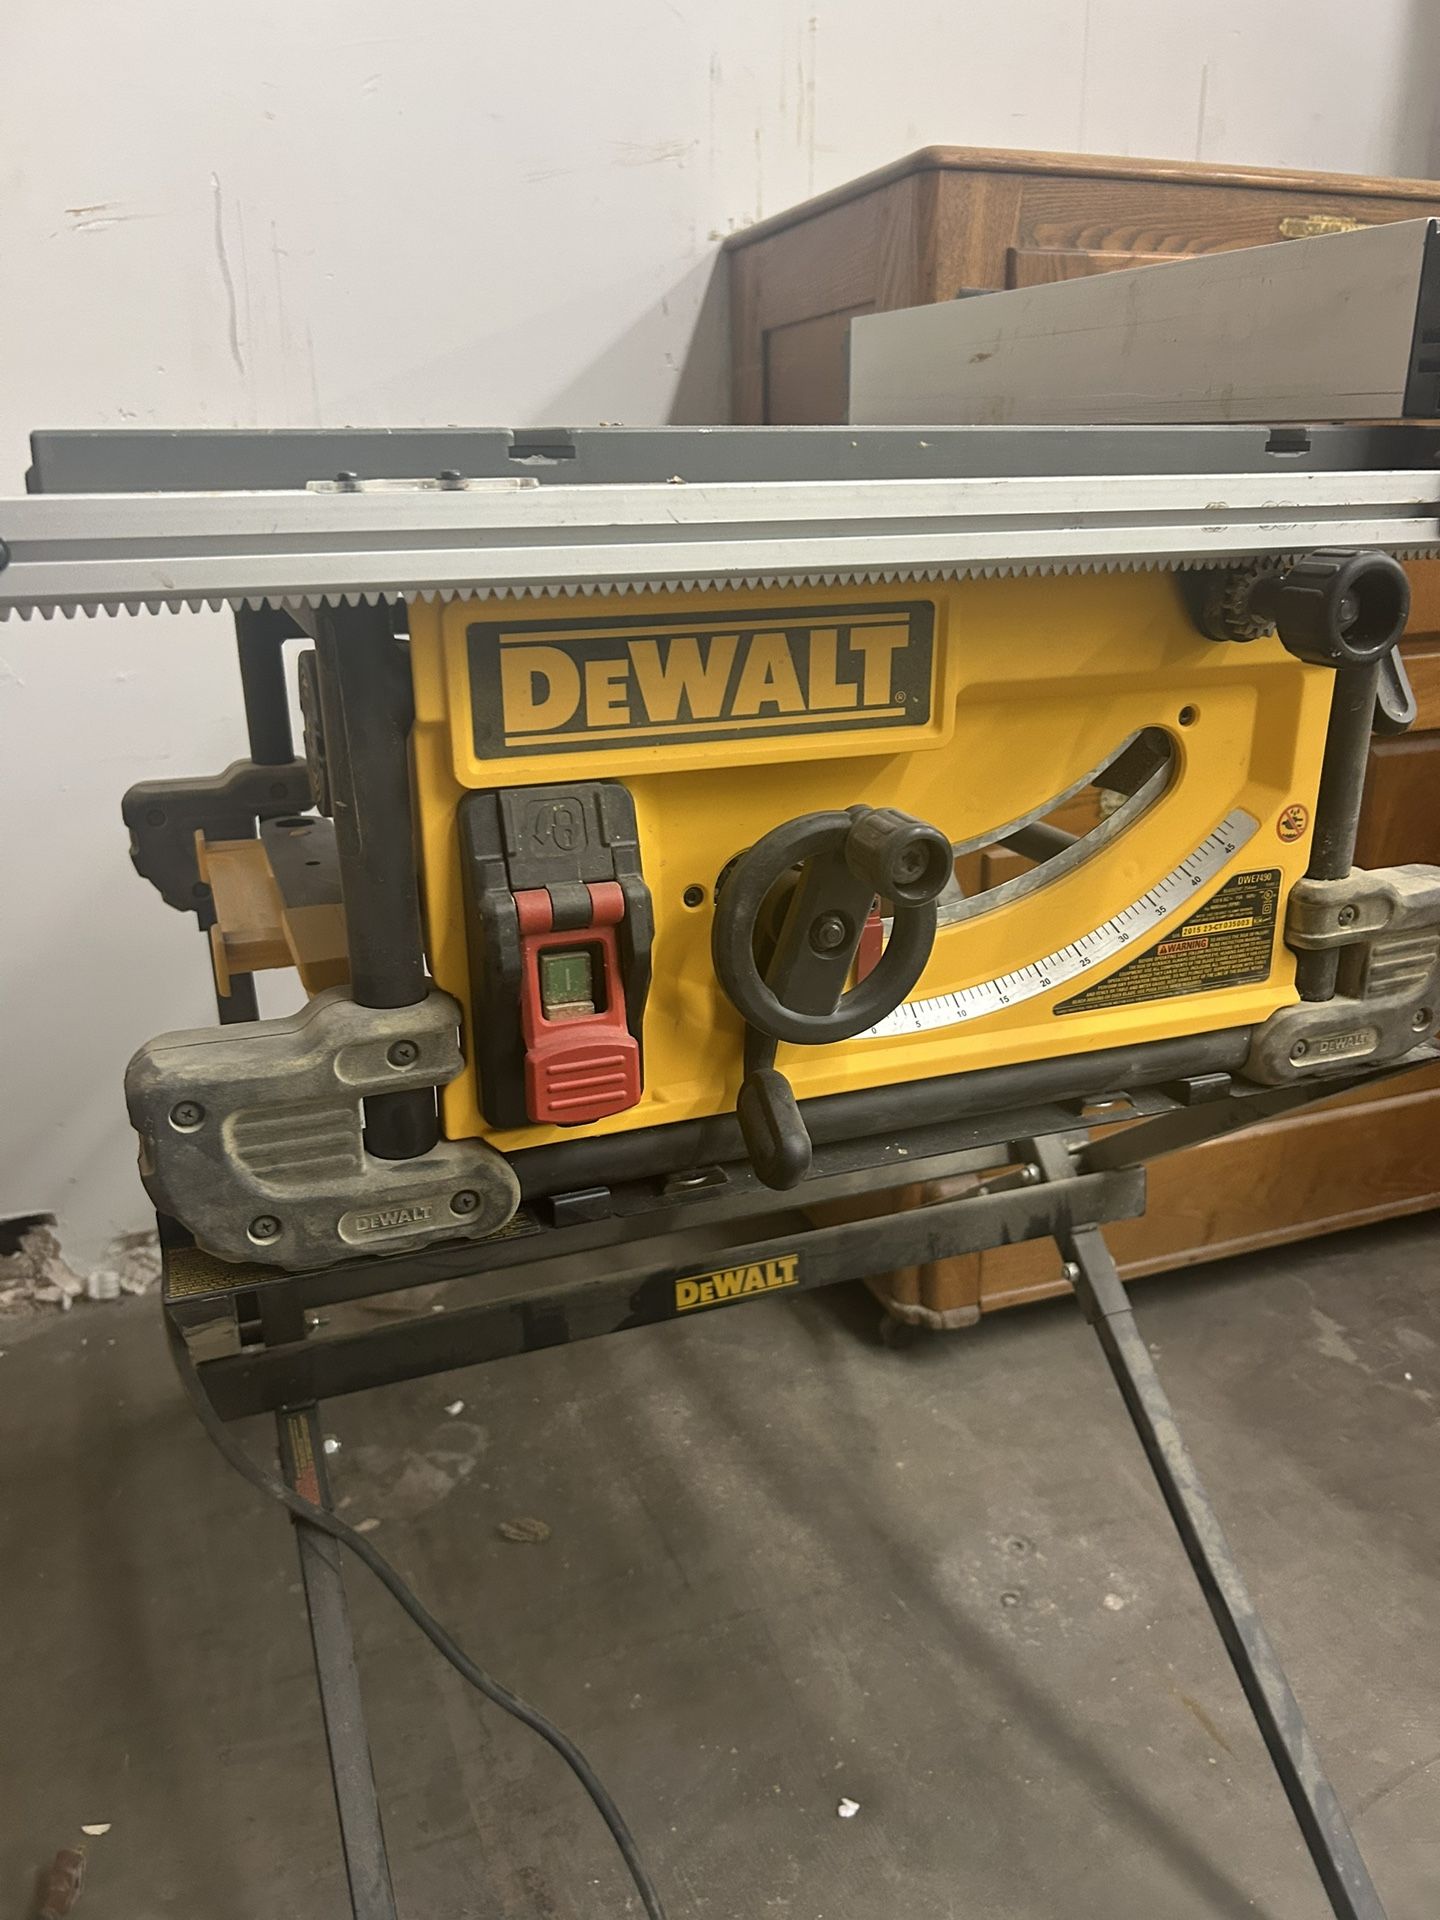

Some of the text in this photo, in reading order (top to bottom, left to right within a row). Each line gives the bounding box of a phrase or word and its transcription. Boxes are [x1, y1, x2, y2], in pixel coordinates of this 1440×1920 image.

[500, 625, 909, 732] DEWALT
[1224, 843, 1235, 854] 45
[1191, 876, 1202, 886] 40
[1238, 873, 1272, 885] DWE7490
[1155, 906, 1166, 916] 35
[1118, 933, 1129, 943] 30
[1168, 939, 1207, 952] WARNING
[1080, 957, 1091, 967] 25
[1040, 978, 1051, 987] 20
[999, 995, 1010, 1004] 15
[957, 1010, 968, 1018] 10
[871, 1027, 877, 1035] 0
[356, 1206, 432, 1231] DEWALT
[676, 1257, 798, 1308] DEWALT
